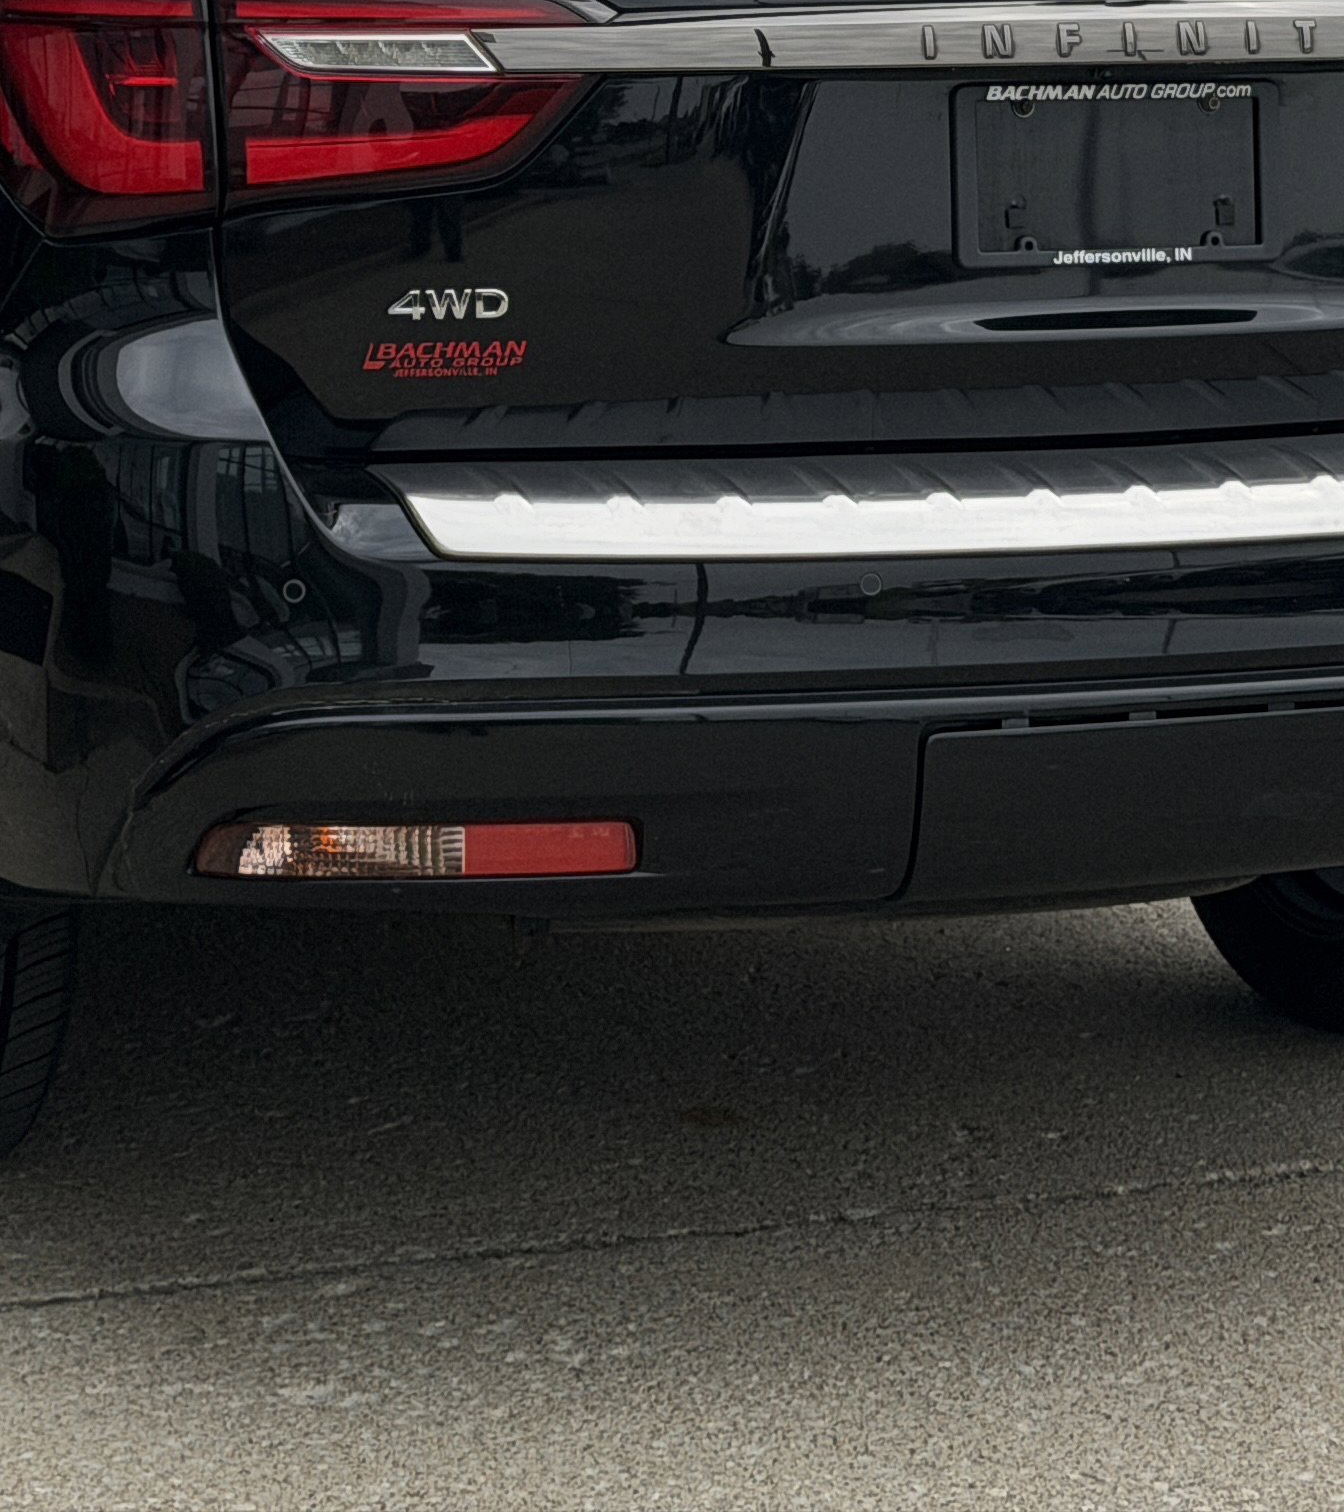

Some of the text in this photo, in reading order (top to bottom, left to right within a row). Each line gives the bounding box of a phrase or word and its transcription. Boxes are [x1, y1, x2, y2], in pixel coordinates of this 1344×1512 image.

[986, 84, 1096, 101] BACHMAN
[1096, 83, 1148, 100] AUTO
[1053, 247, 1193, 265] Jeffersonville, IN
[387, 288, 509, 320] 4WD
[377, 340, 528, 359] BACHMAN
[388, 356, 524, 369] AUTO GROUP
